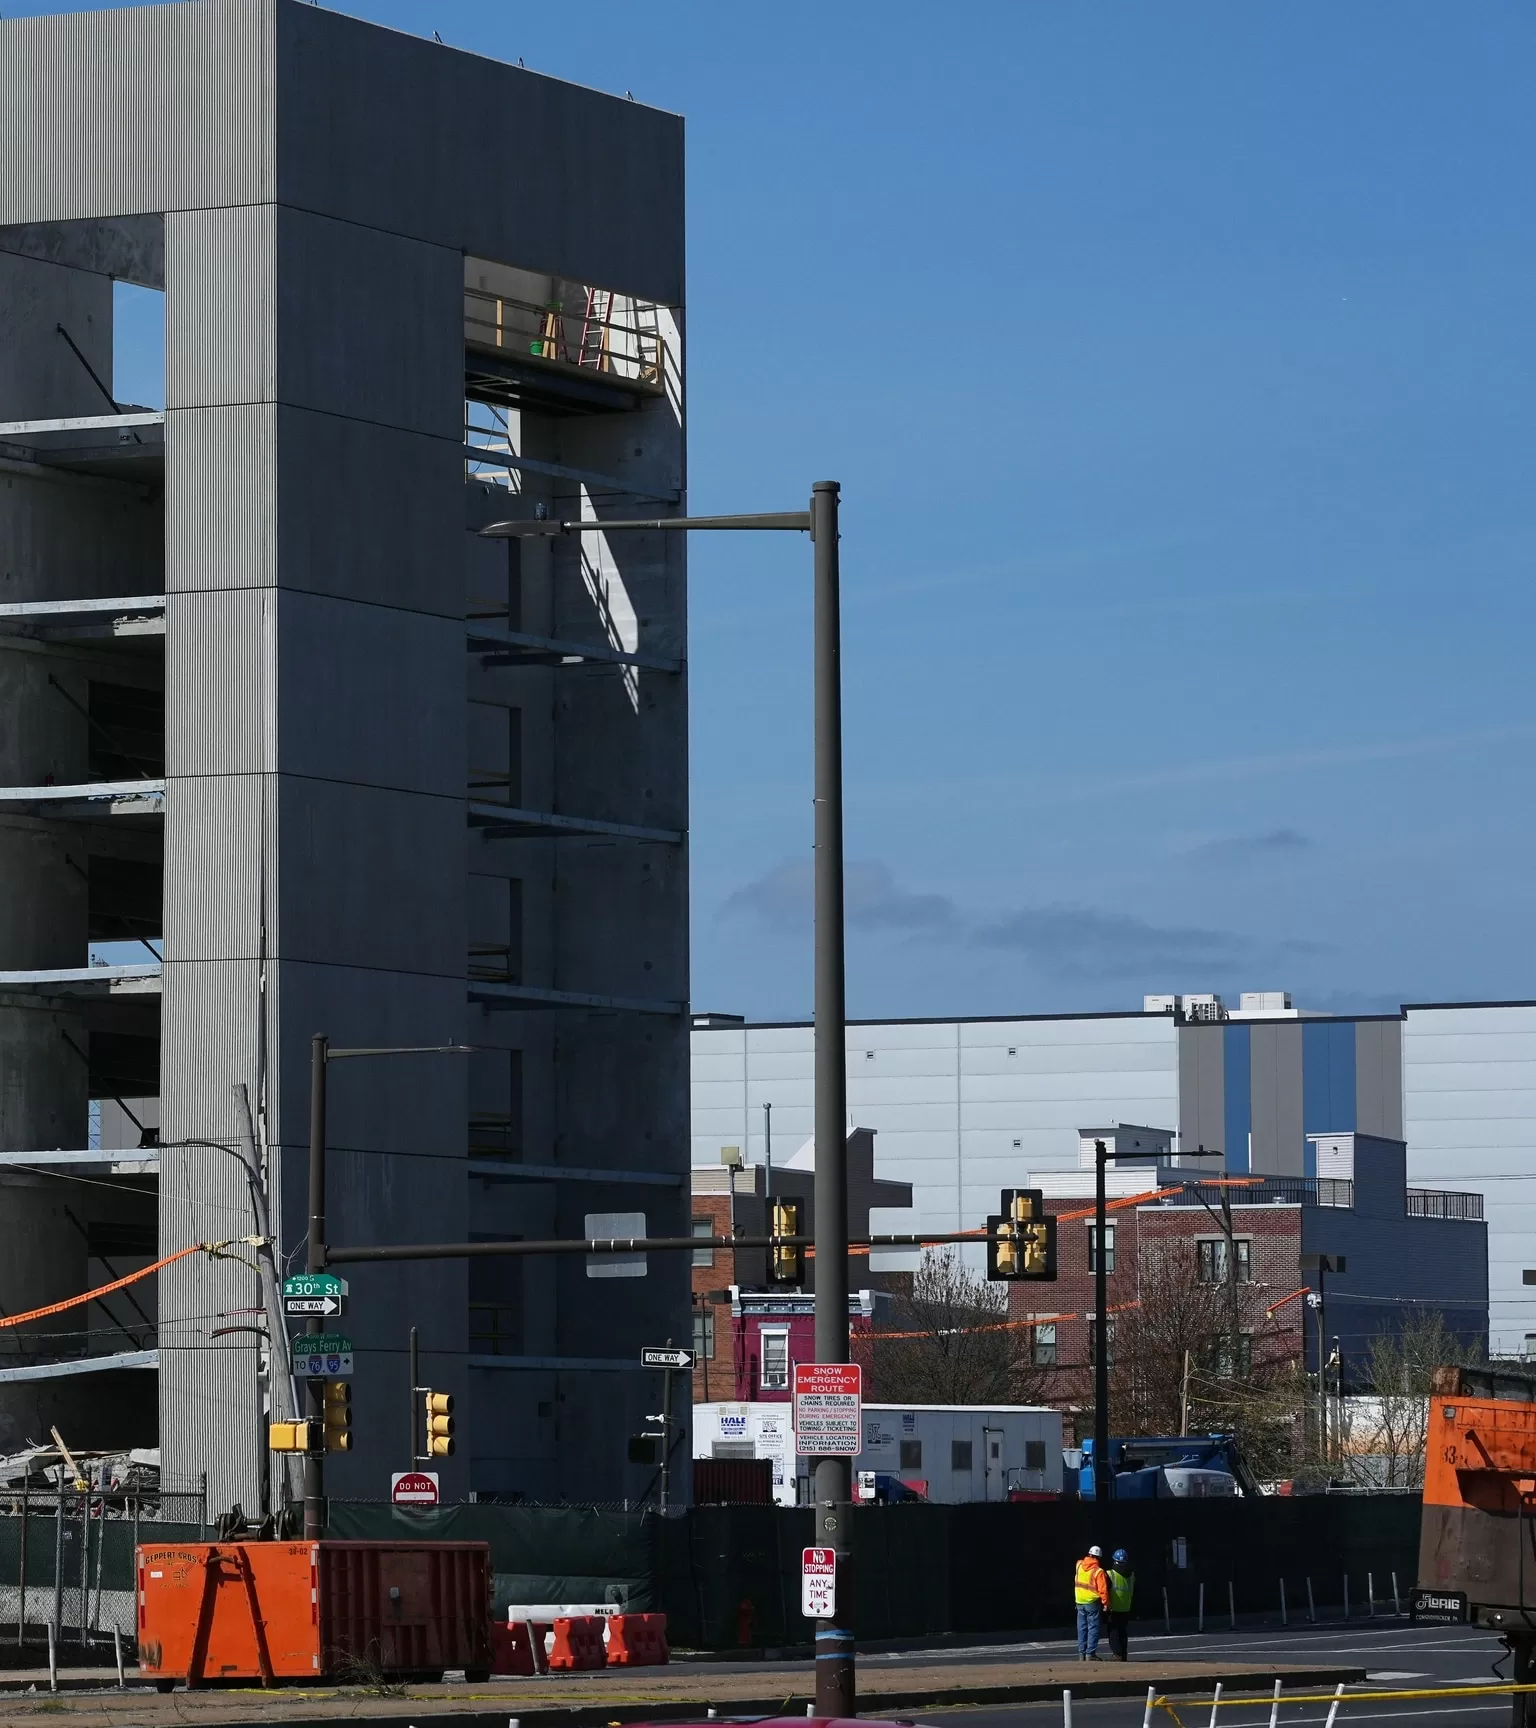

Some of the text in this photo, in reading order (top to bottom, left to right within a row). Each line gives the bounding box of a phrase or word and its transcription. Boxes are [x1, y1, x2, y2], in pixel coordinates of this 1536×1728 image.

[295, 1283, 338, 1294] 30th St
[295, 1340, 351, 1354] Grays Ferry Av
[295, 1361, 338, 1370] TO 76 95
[414, 1482, 431, 1490] NOT
[145, 1551, 175, 1564] GEPPERT
[813, 1550, 825, 1563] NO
[804, 1564, 833, 1573] STOPPING
[810, 1579, 827, 1587] ANY
[809, 1591, 828, 1599] TIME
[1415, 1594, 1460, 1610] FLORIG
